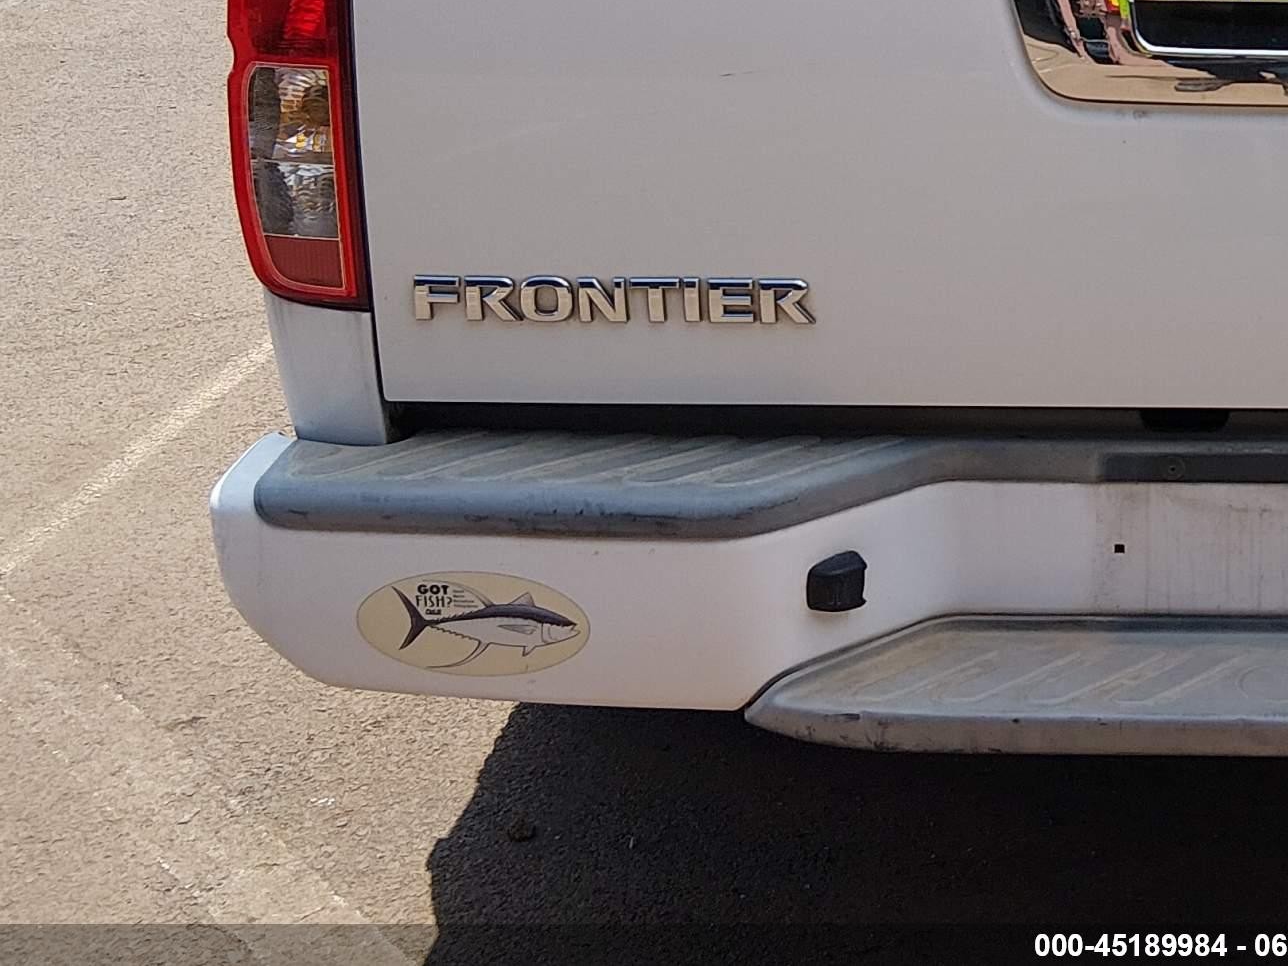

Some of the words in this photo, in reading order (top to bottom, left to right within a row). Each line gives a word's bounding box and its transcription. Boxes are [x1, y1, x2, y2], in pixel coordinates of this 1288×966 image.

[413, 274, 817, 324] FRONTIER
[417, 584, 450, 595] GOT
[416, 595, 453, 608] FISH?
